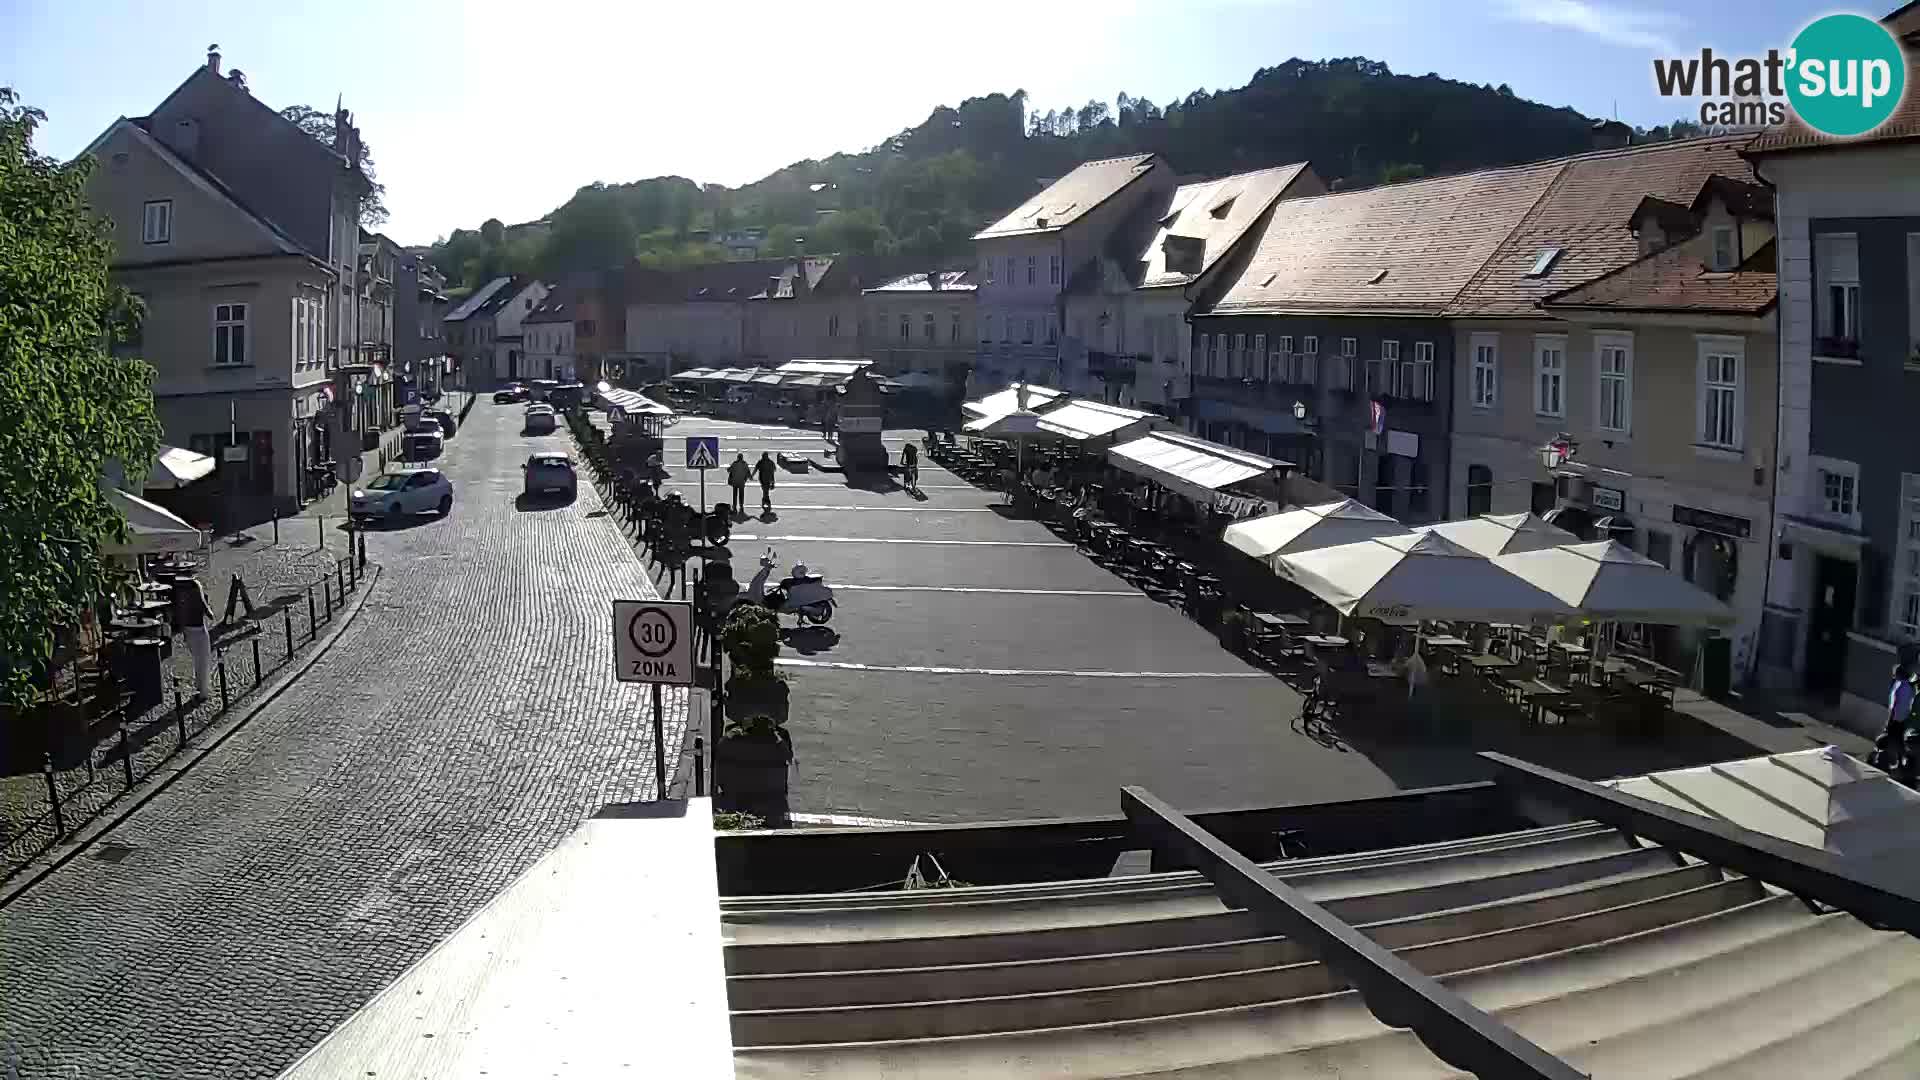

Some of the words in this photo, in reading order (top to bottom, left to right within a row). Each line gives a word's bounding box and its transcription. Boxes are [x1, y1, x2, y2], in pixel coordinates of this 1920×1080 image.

[407, 391, 416, 401] P
[641, 623, 666, 643] 30
[632, 660, 676, 677] ZONA
